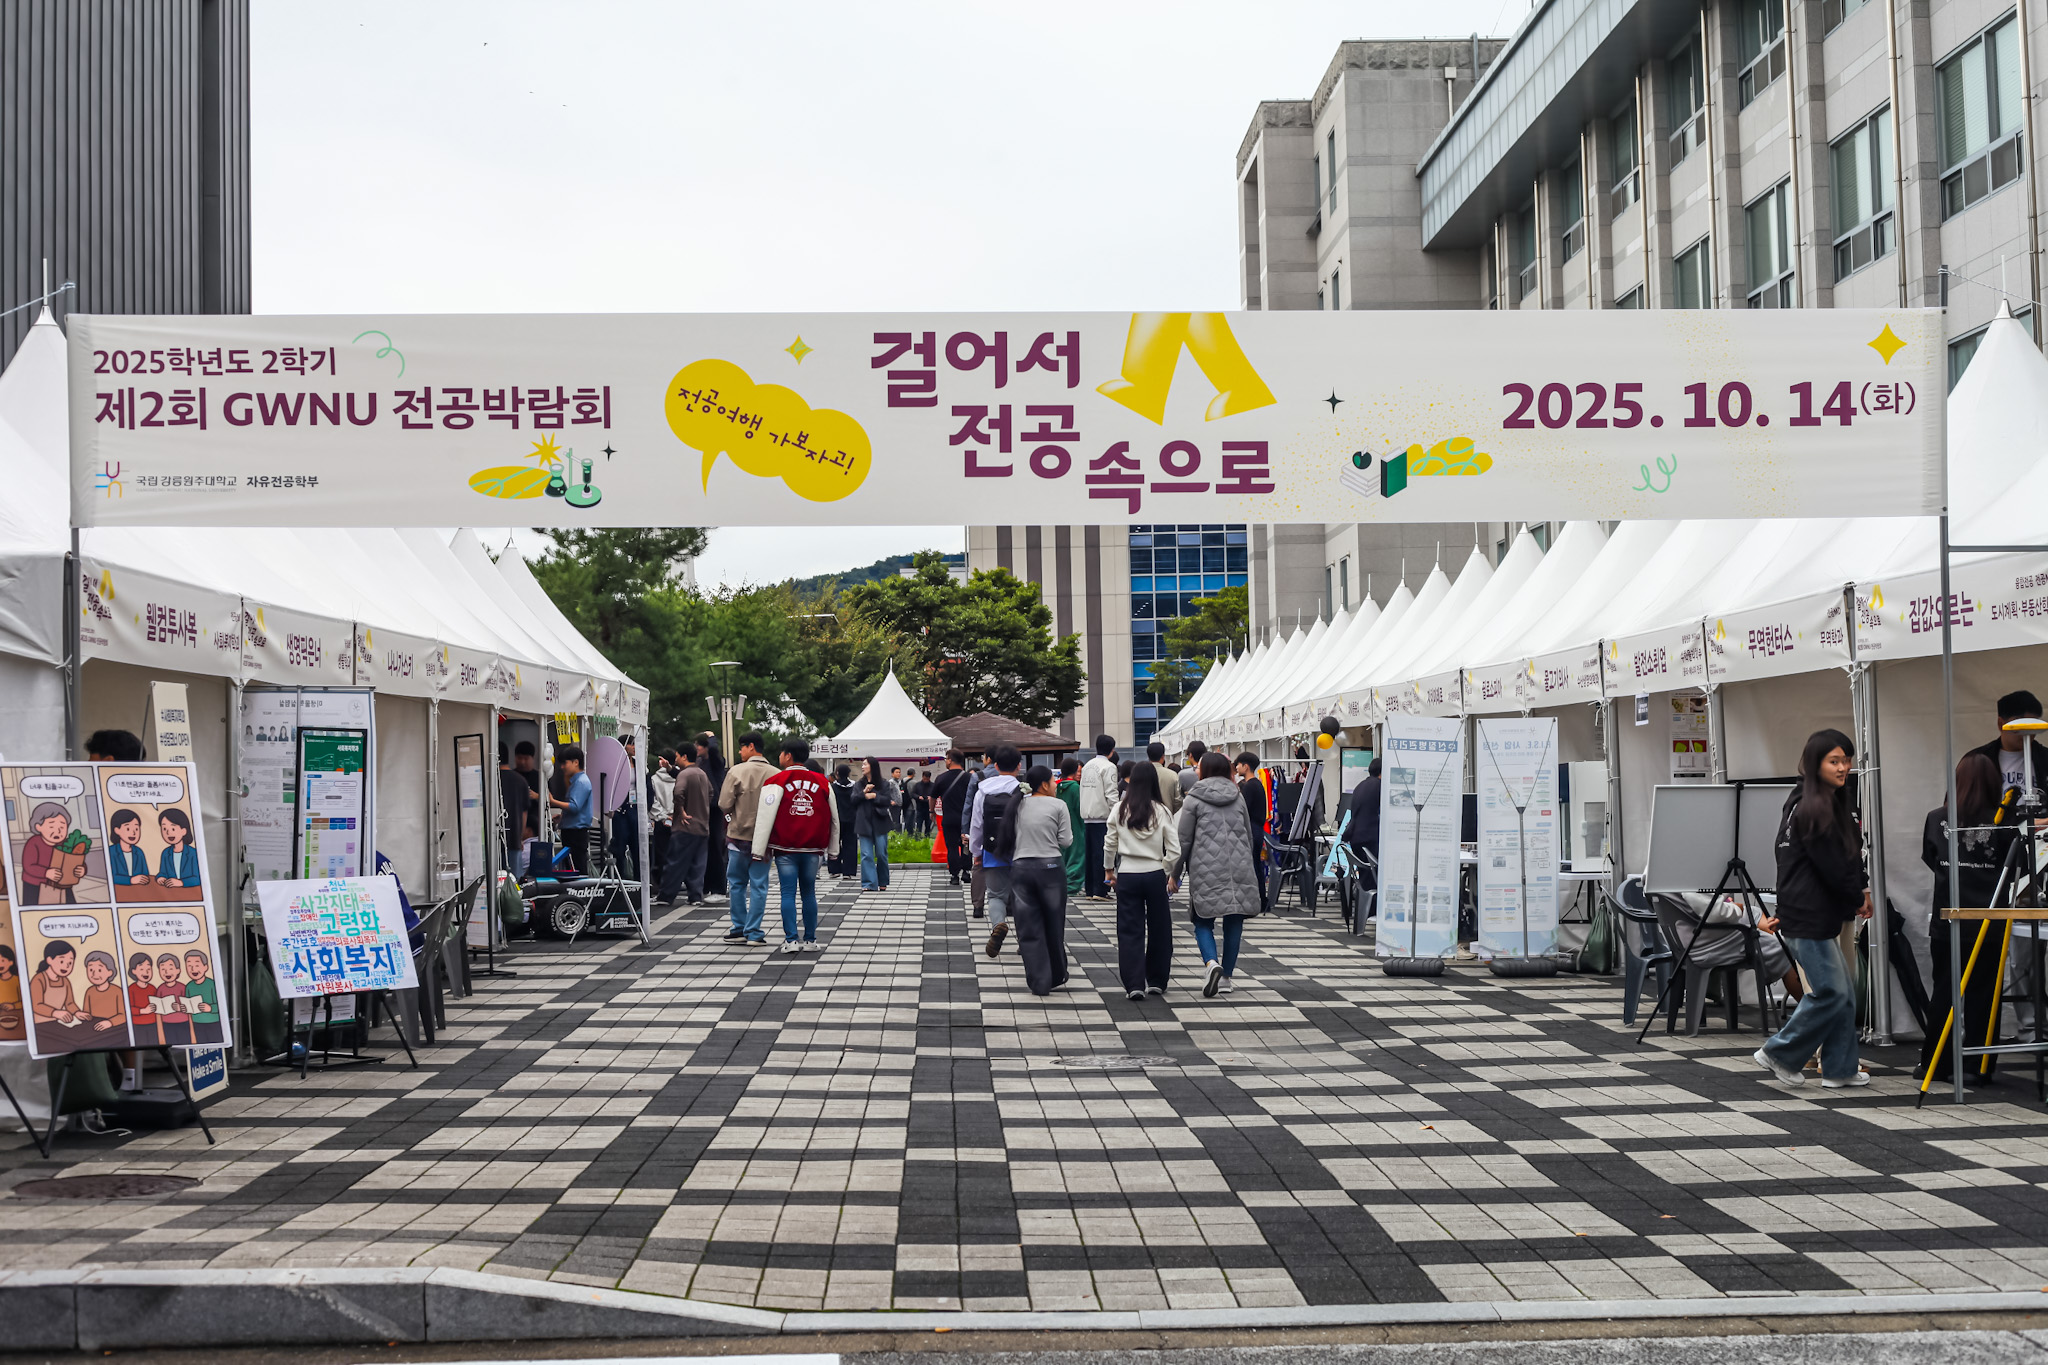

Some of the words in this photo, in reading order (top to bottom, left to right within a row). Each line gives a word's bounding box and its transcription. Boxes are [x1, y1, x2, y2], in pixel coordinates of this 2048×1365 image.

[93, 347, 254, 376] 2025학년도
[262, 347, 338, 375] 2학기
[871, 331, 1080, 408] 걸어서
[94, 387, 209, 431] 제2회
[222, 391, 378, 428] GWNU
[392, 385, 612, 431] 전공박람회
[1501, 382, 1663, 429] 2025.
[1683, 382, 1770, 428] 10.
[1788, 380, 1917, 428] 14(화)
[677, 386, 764, 441] 전공여행
[769, 430, 855, 477] 가보자고!
[948, 404, 1081, 479] 전공
[1084, 439, 1276, 515] 속으로
[136, 475, 158, 487] 국립
[160, 475, 237, 487] 강릉원주대학교
[246, 475, 319, 488] 자유전공학부
[146, 602, 198, 648] 웰컴투사복
[1748, 622, 1794, 659] 무역헌터스
[1820, 627, 1844, 648] 무역학과
[1544, 665, 1569, 692] 물고기의사
[809, 744, 848, 754] 마트건설
[785, 780, 820, 793] GWNU
[328, 879, 347, 892] 청년
[566, 886, 605, 898] makita
[300, 892, 360, 913] 사각지대
[319, 910, 380, 936] 고령화
[282, 936, 319, 949] 주간보호
[336, 935, 378, 946] 의료사회복지
[292, 943, 397, 981] 사회복지
[315, 980, 353, 995] 자원봉사
[352, 977, 396, 988] 학교사회복지
[192, 1063, 206, 1080] Make
[205, 1064, 209, 1075] a
[209, 1056, 223, 1073] Smile
